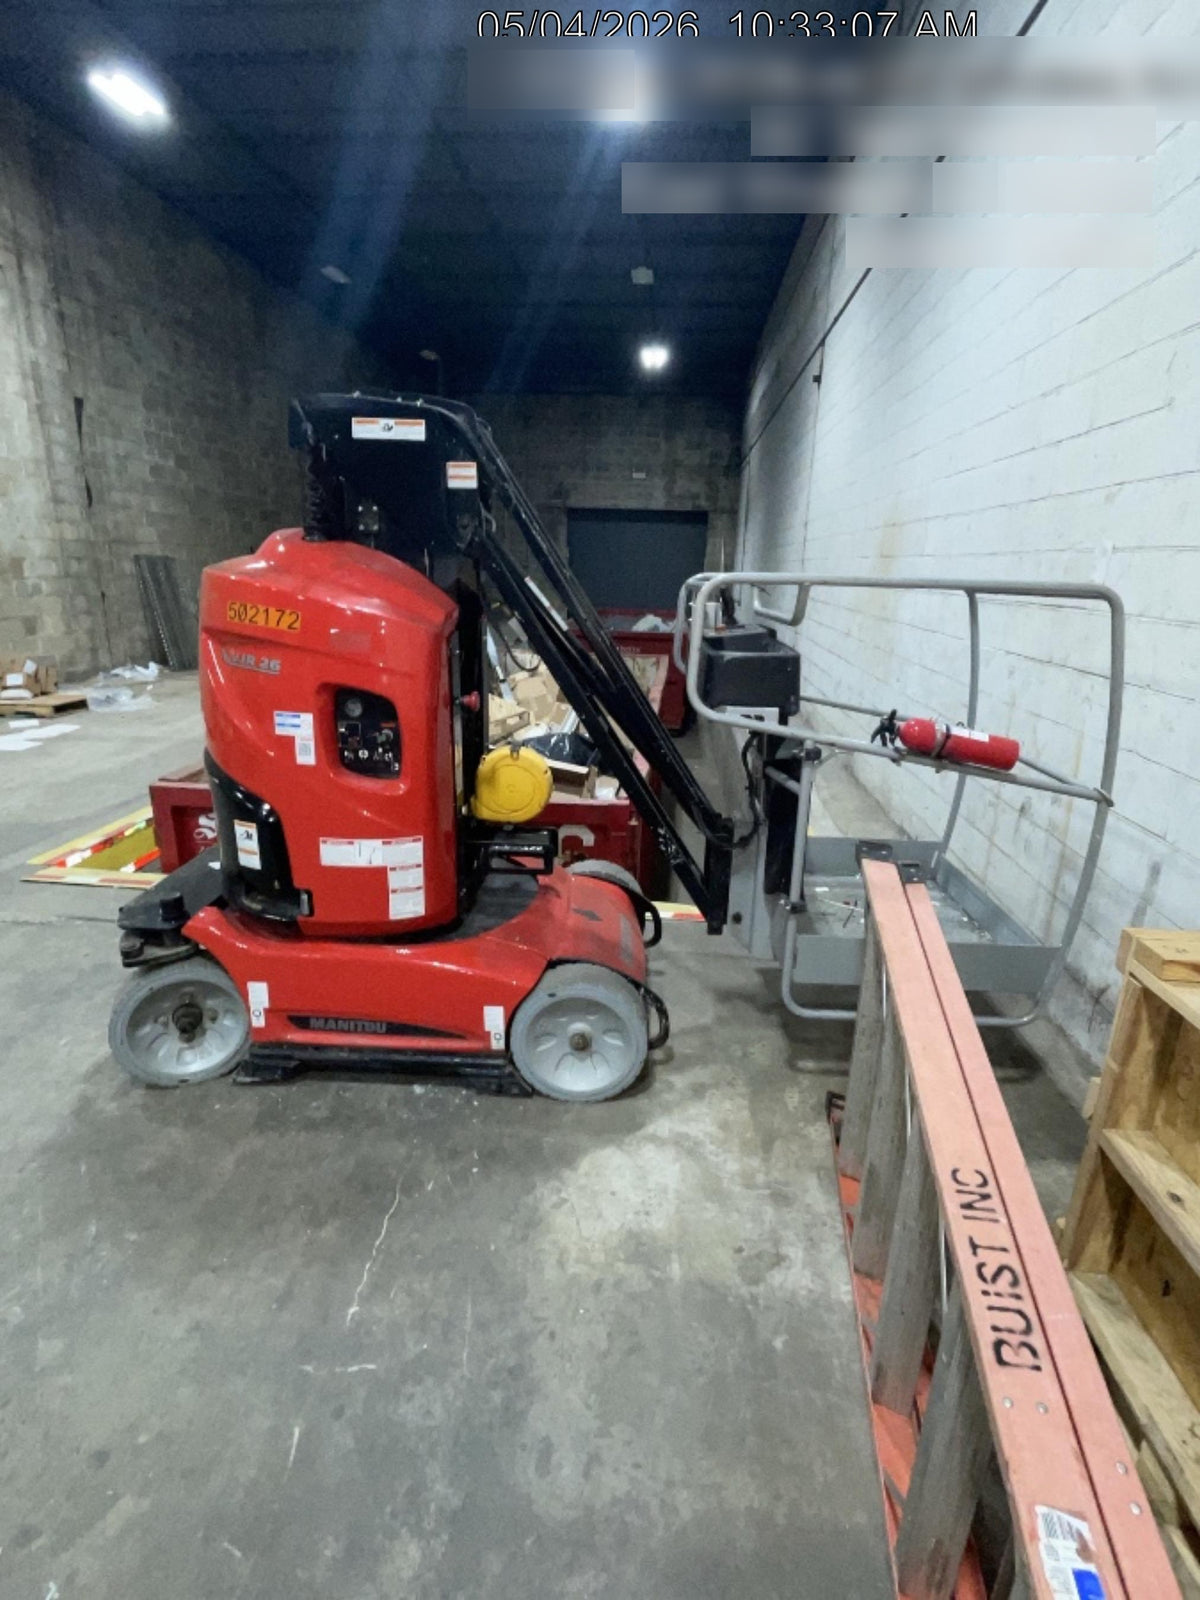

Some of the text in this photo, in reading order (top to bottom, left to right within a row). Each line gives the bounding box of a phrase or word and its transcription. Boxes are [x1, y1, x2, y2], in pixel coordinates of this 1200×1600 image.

[228, 602, 300, 630] 502172
[309, 1017, 387, 1033] MANITOU
[951, 1167, 1000, 1223] INC
